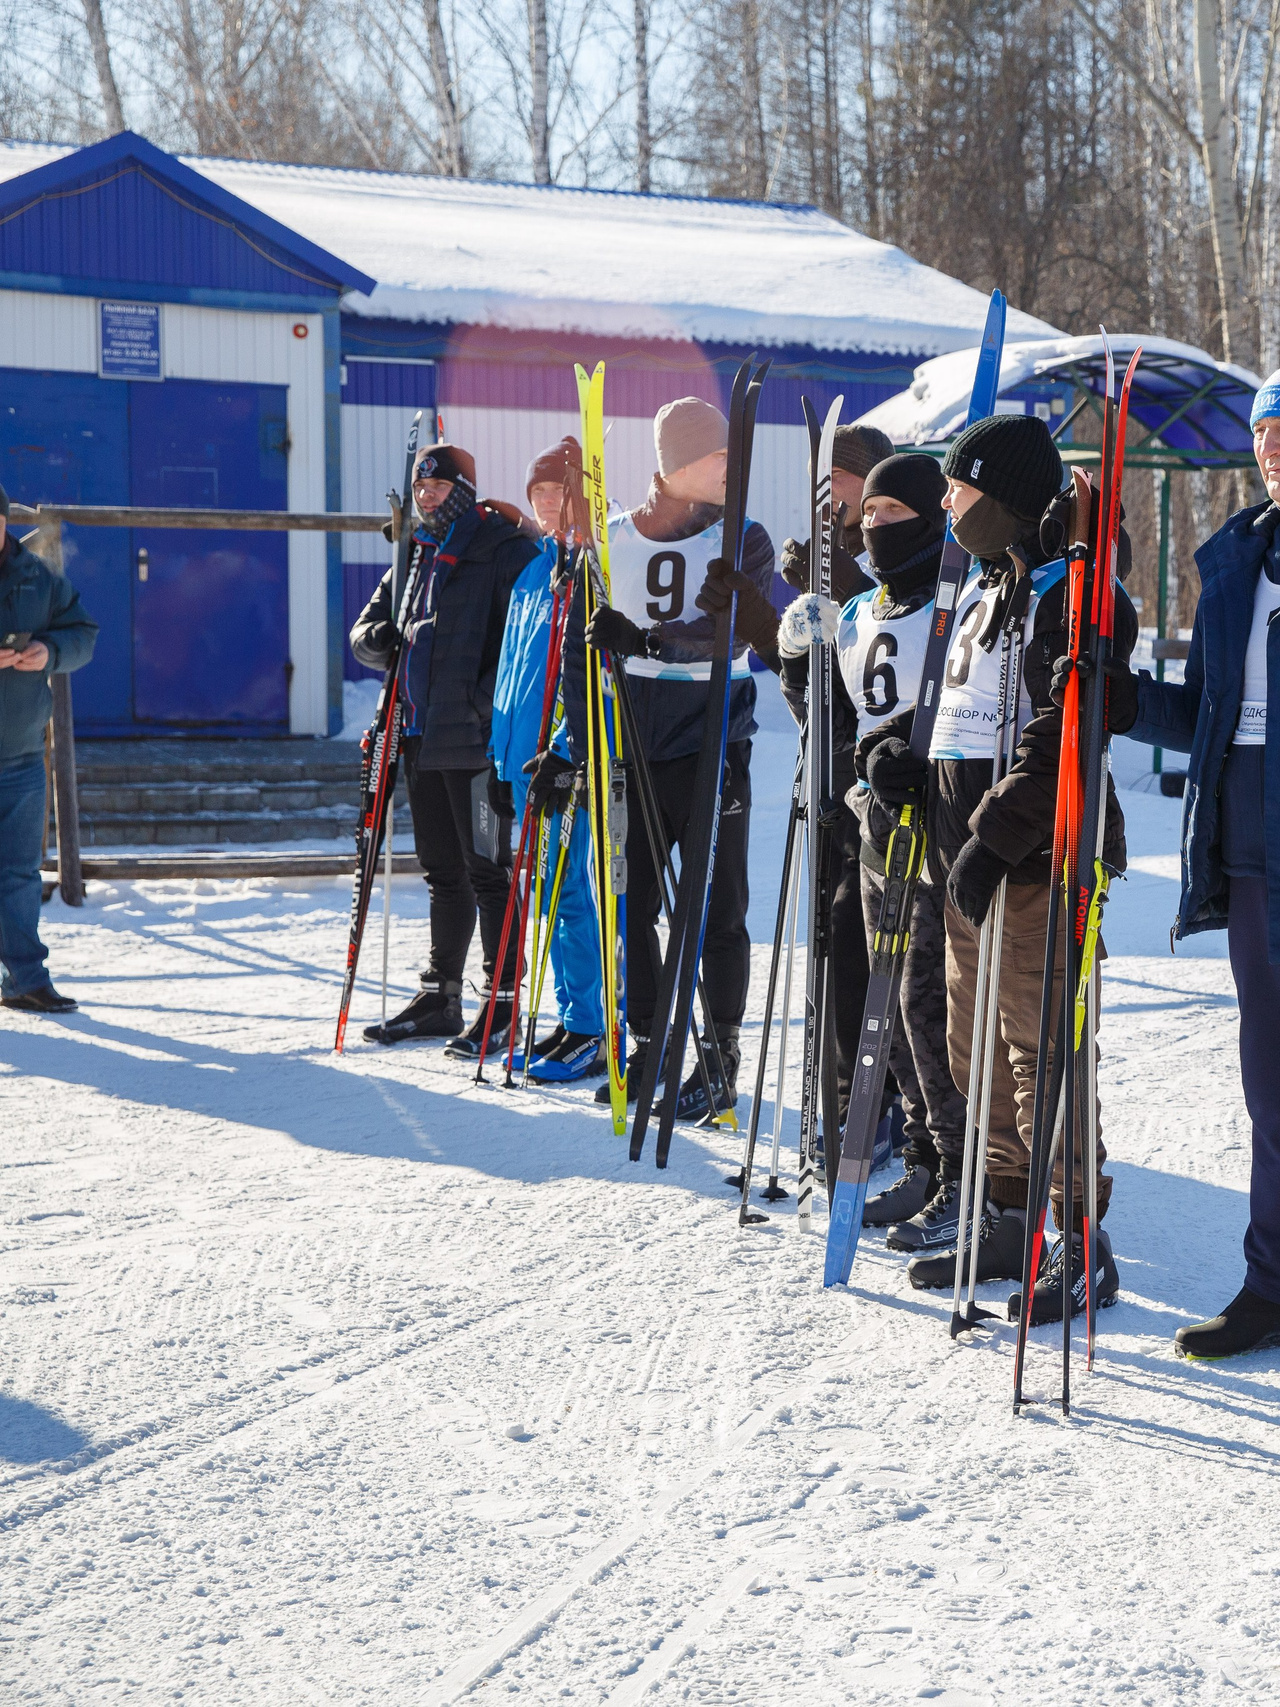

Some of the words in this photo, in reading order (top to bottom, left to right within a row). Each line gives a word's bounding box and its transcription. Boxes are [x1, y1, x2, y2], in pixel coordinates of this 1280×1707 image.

[593, 455, 605, 544] FISCHER
[646, 551, 686, 621] 9
[820, 517, 831, 599] VERSAL
[936, 612, 947, 636] PRO
[946, 601, 988, 688] 3
[863, 632, 899, 716] 6
[997, 657, 1008, 716] NORDWAY
[368, 729, 387, 793] ROSSIGNOL
[387, 702, 402, 765] ROSSIGNOL
[559, 790, 577, 849] CHER
[722, 808, 743, 816] DEMIX
[539, 816, 551, 880] FISCHE
[1074, 885, 1089, 947] ATOMIC
